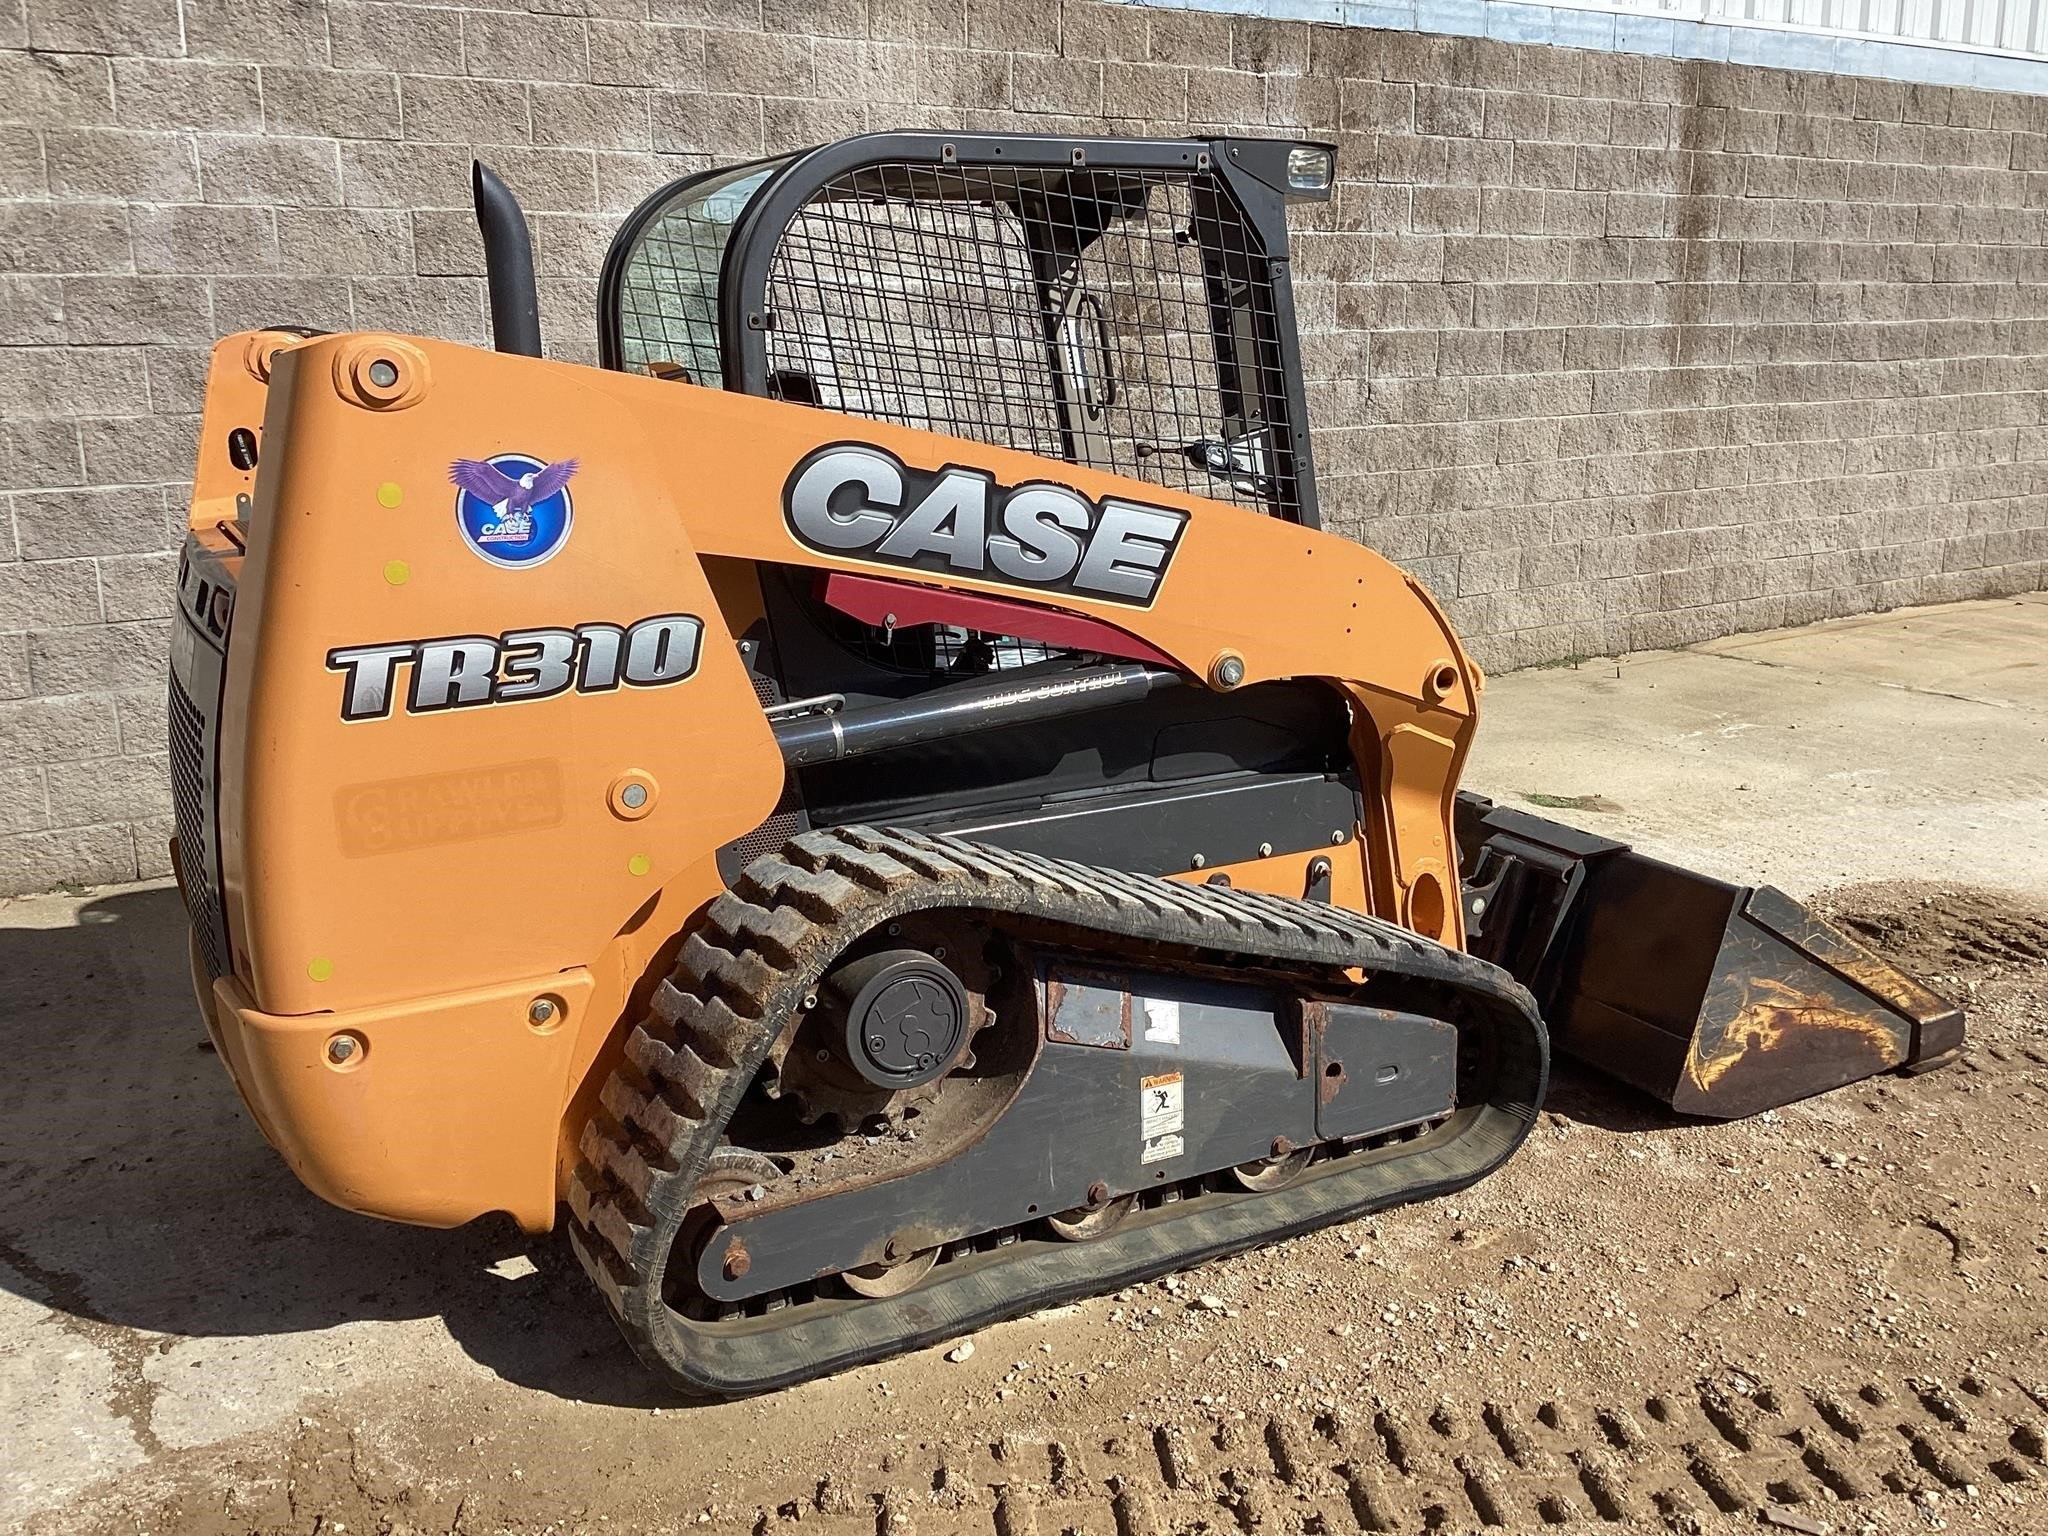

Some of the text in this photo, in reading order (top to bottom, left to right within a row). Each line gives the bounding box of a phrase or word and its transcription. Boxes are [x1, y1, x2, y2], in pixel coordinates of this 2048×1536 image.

[481, 522, 532, 534] CASE
[786, 444, 1188, 606] CASE
[328, 616, 703, 721] TR310
[1153, 1073, 1180, 1086] WARNING
